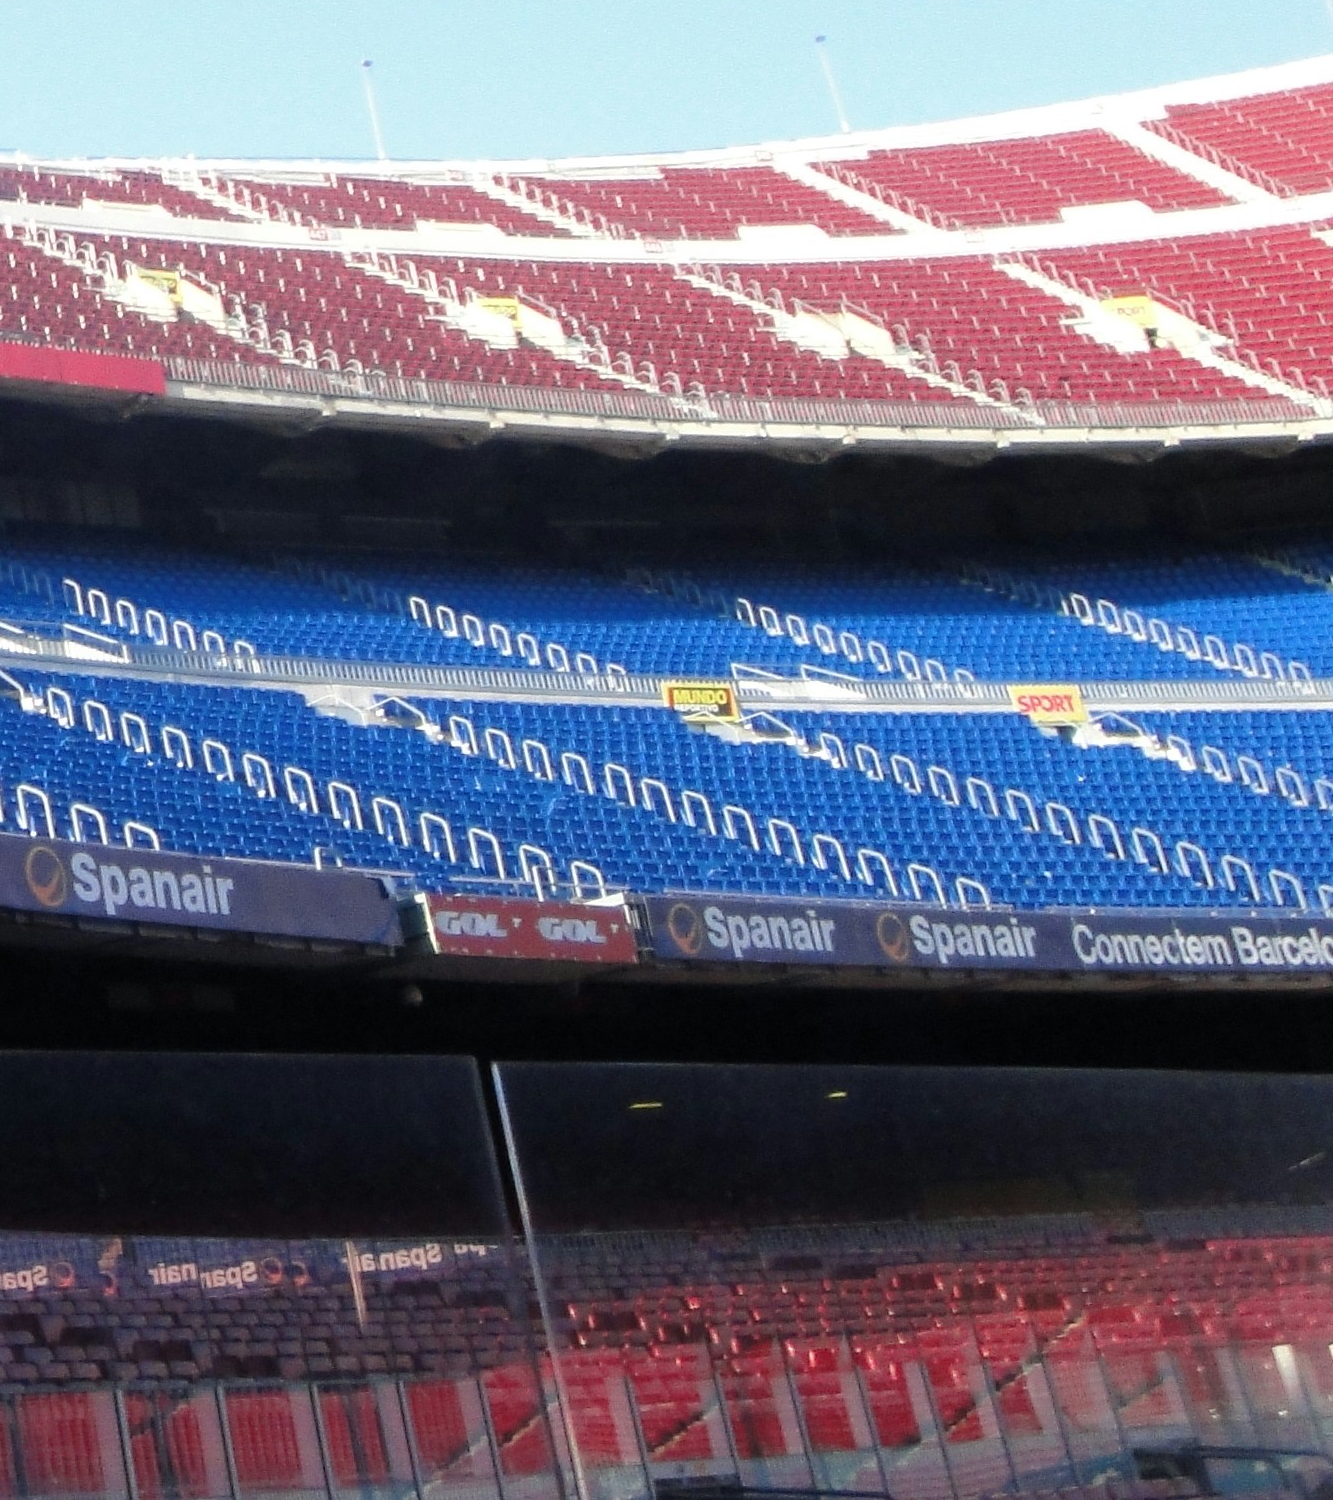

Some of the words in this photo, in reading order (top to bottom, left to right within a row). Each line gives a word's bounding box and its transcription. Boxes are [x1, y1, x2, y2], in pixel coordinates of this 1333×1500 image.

[673, 688, 728, 705] MUNDO
[1017, 694, 1075, 713] SPORT
[70, 852, 234, 916] Spanair
[435, 910, 508, 938] GOL
[536, 916, 607, 944] GOL
[703, 905, 836, 958] Spanair
[908, 914, 1038, 965] Spanair
[1071, 924, 1233, 966] Connectem
